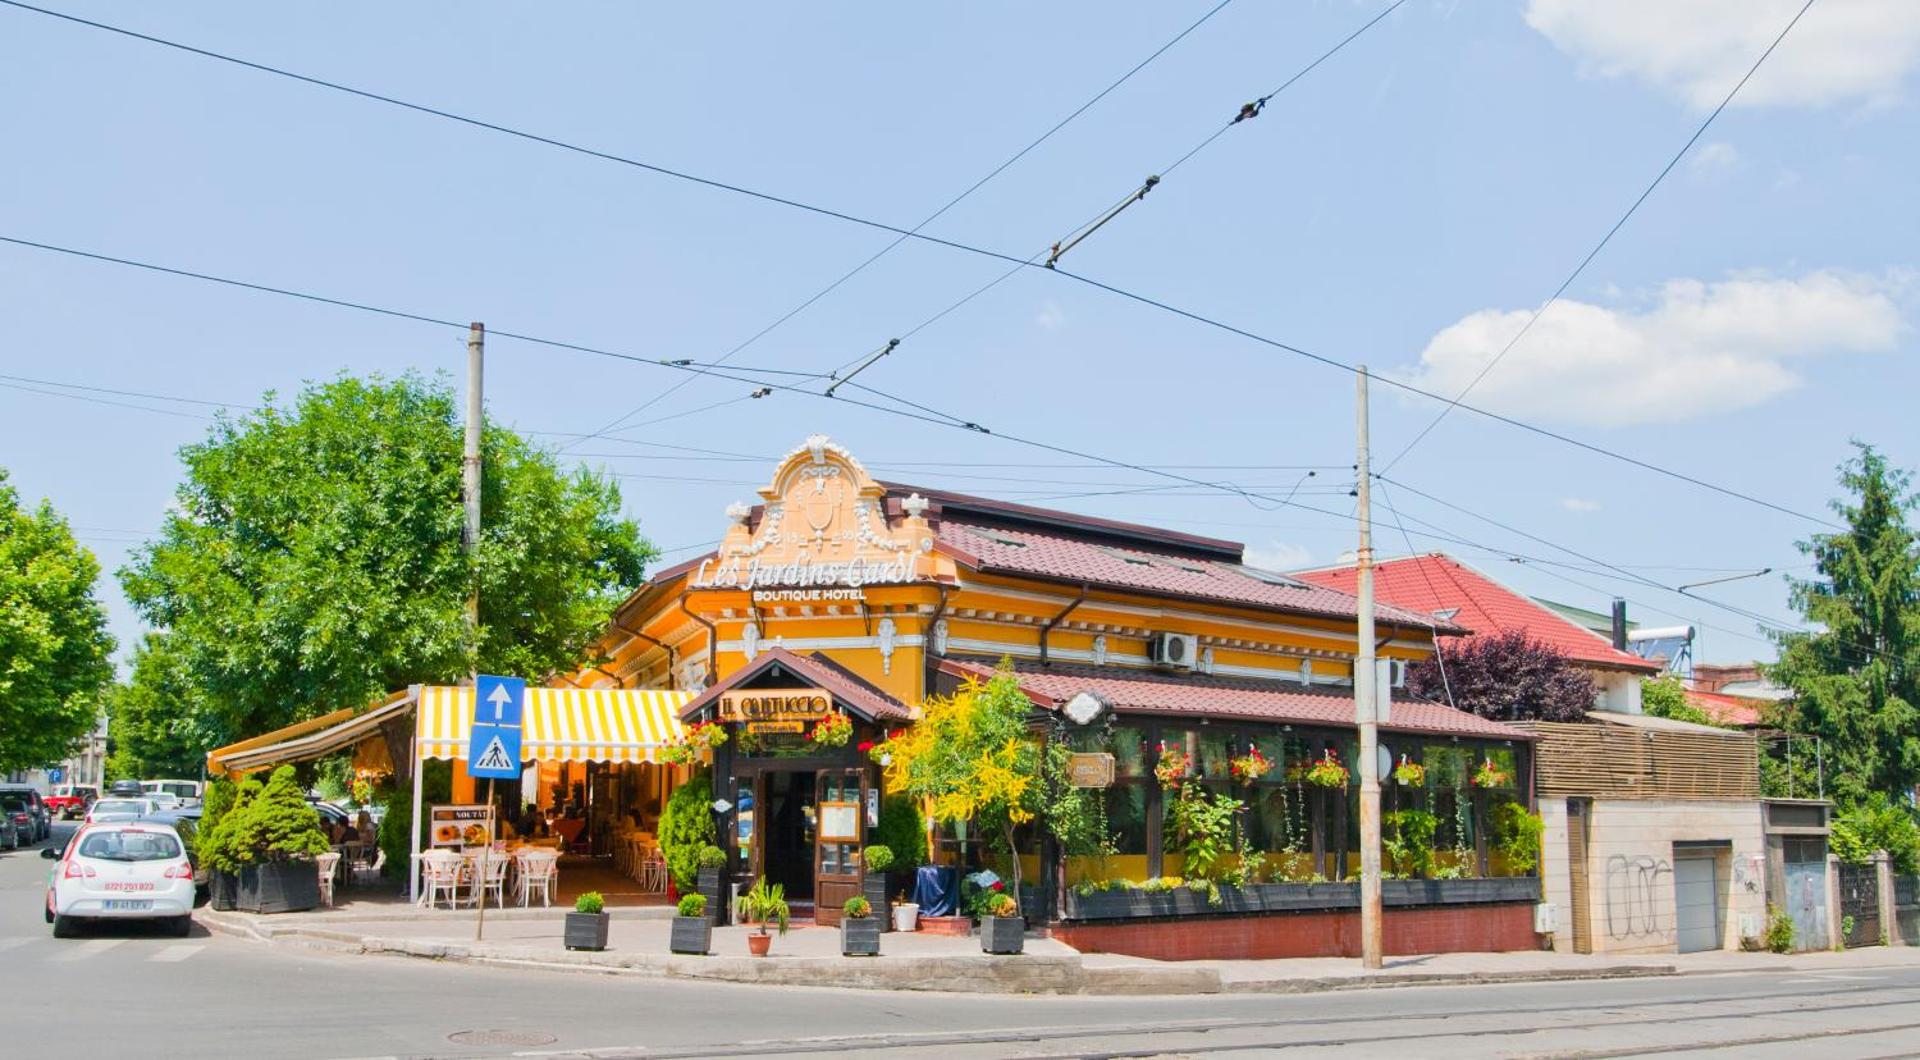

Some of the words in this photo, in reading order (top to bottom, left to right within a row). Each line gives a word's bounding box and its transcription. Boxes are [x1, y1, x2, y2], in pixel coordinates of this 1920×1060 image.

[693, 557, 739, 587] Les
[739, 557, 837, 590] Jardins
[846, 550, 922, 588] Carol
[753, 589, 820, 602] BOUTIQUE
[823, 587, 867, 600] HOTEL
